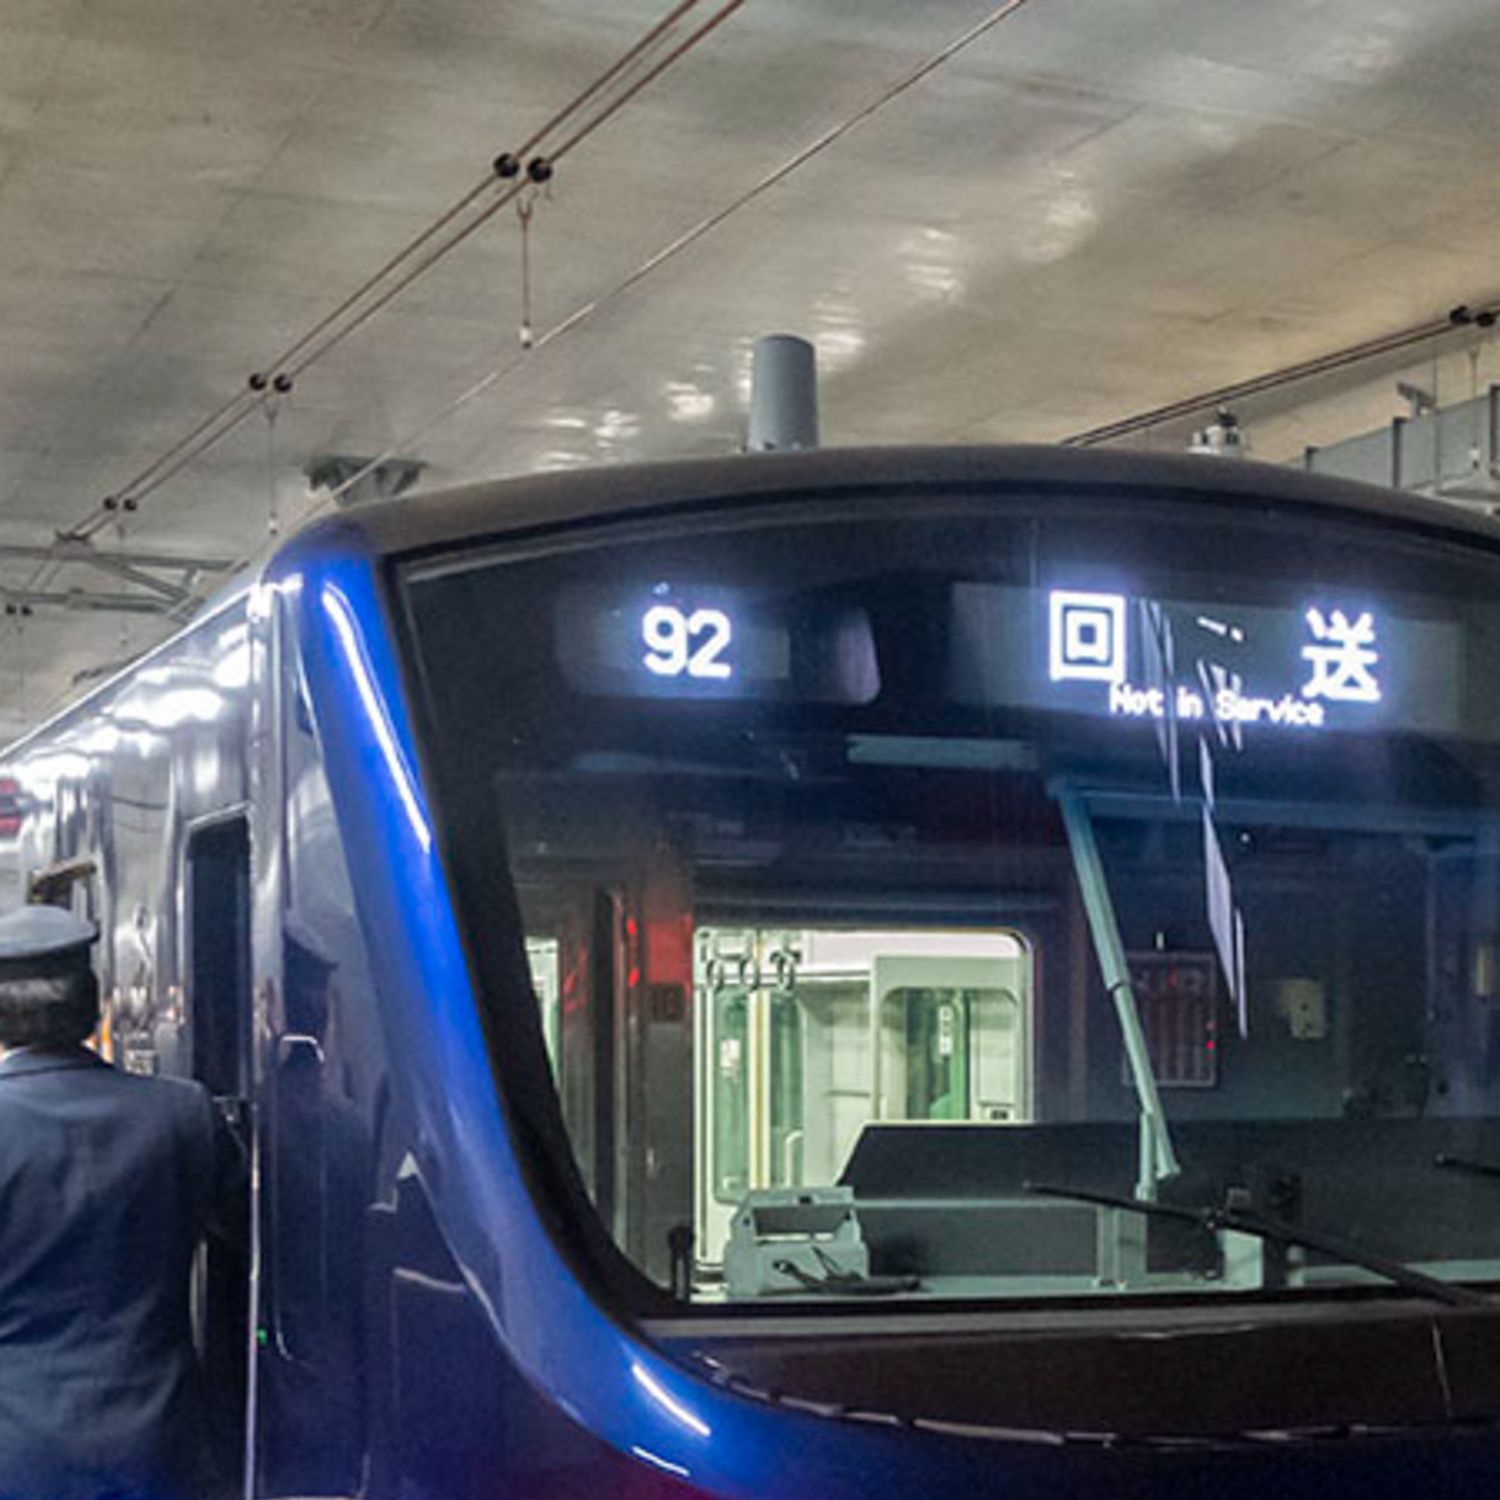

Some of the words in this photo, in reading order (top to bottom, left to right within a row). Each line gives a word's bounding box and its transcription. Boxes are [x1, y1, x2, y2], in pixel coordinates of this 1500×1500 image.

[642, 605, 731, 678] 92
[1109, 683, 1163, 717] Not
[1177, 686, 1202, 718] in
[1215, 689, 1324, 727] Service
